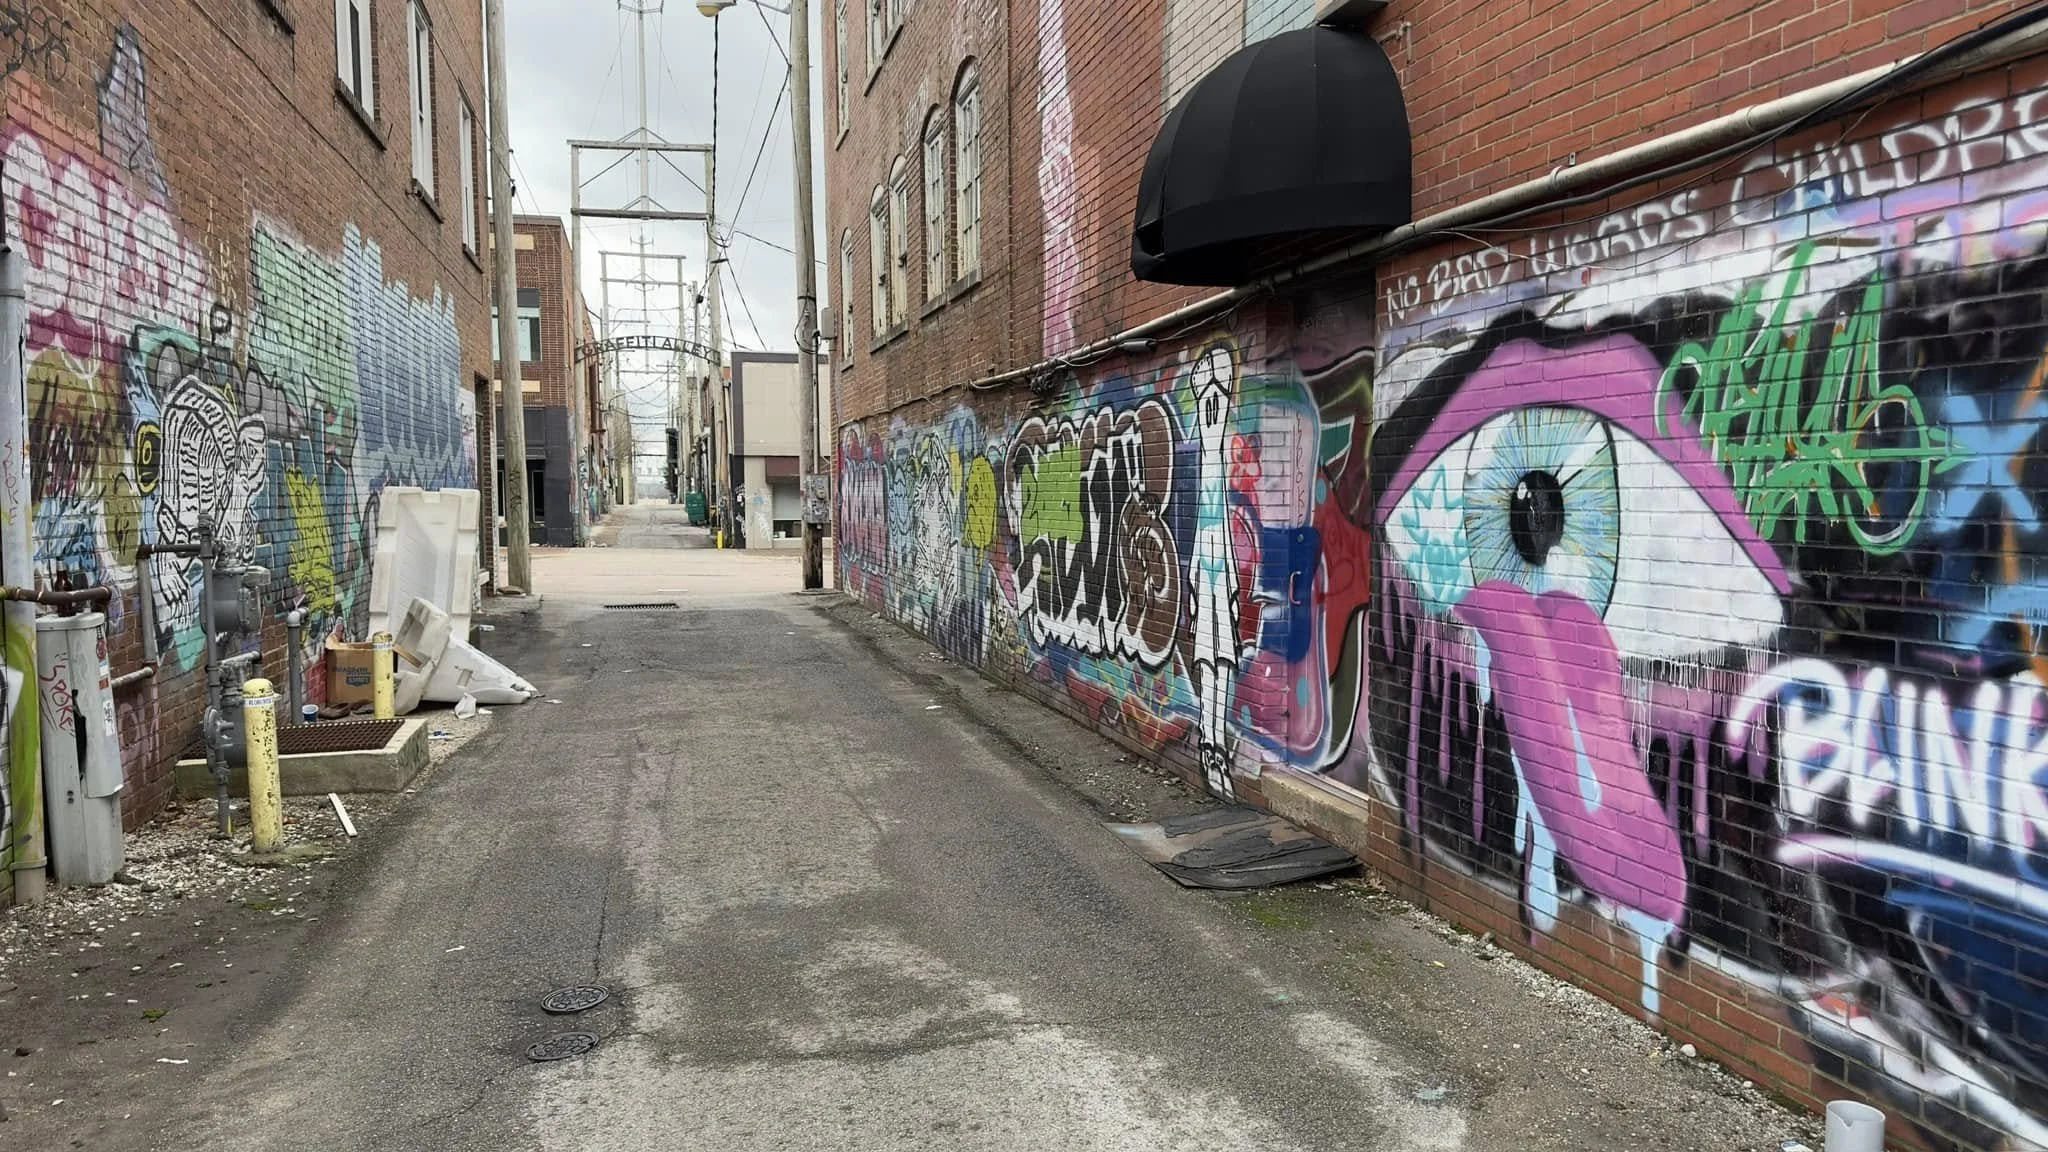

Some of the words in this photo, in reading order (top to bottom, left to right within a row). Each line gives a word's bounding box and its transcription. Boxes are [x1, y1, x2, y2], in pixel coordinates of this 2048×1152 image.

[1385, 275, 1421, 324] NO
[1427, 247, 1509, 315] BAD
[1530, 188, 1706, 276] WORDS
[582, 334, 656, 357] GRAFFITI
[662, 337, 714, 362] ALLEY
